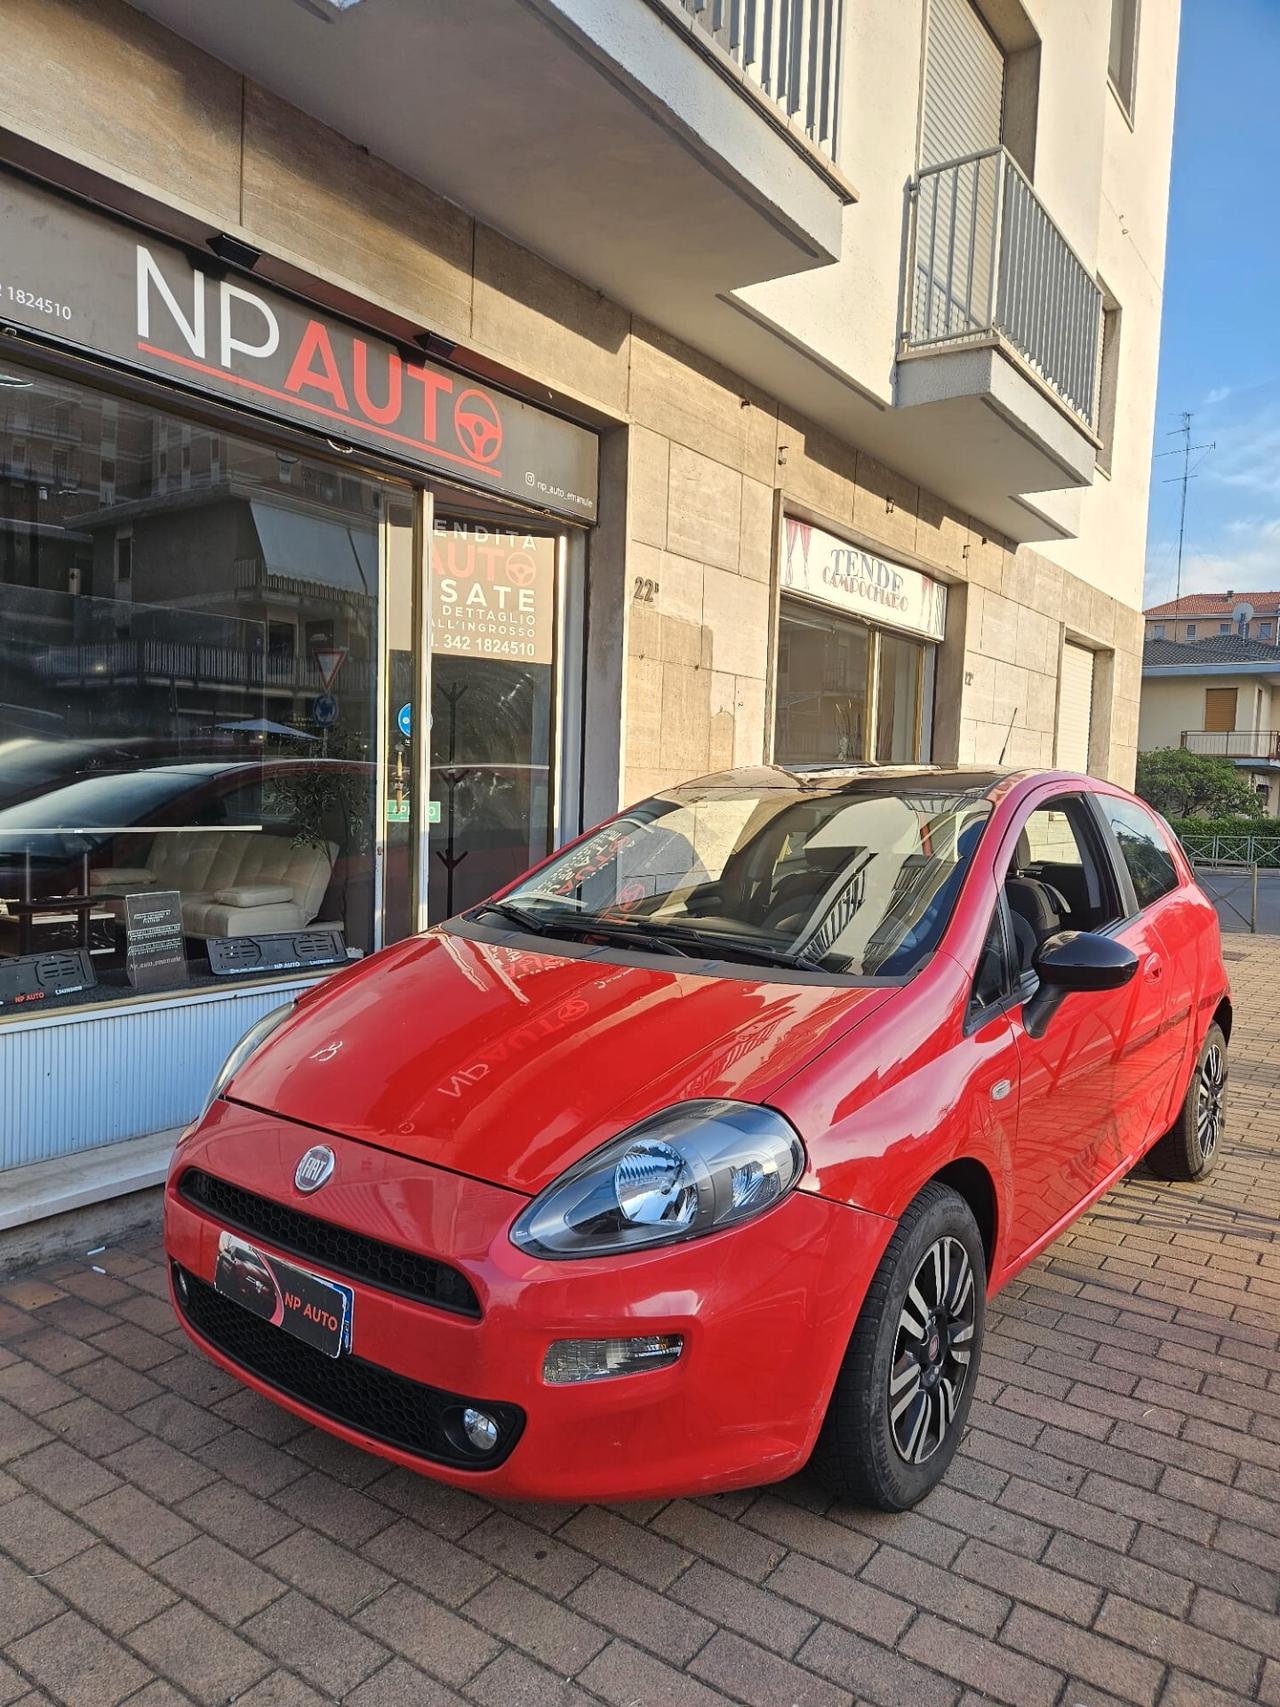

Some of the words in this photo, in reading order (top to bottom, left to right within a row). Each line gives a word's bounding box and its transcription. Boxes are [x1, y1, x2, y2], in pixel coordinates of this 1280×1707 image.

[7, 286, 72, 320] 1824510
[433, 518, 537, 551] ENDITA
[439, 578, 536, 613] SATE
[442, 604, 536, 626] DETTAGLIO
[443, 634, 472, 650] 342
[475, 637, 536, 657] 1824510
[301, 1156, 327, 1182] FIAT
[284, 1291, 302, 1311] NP
[303, 1303, 339, 1332] AUTO
